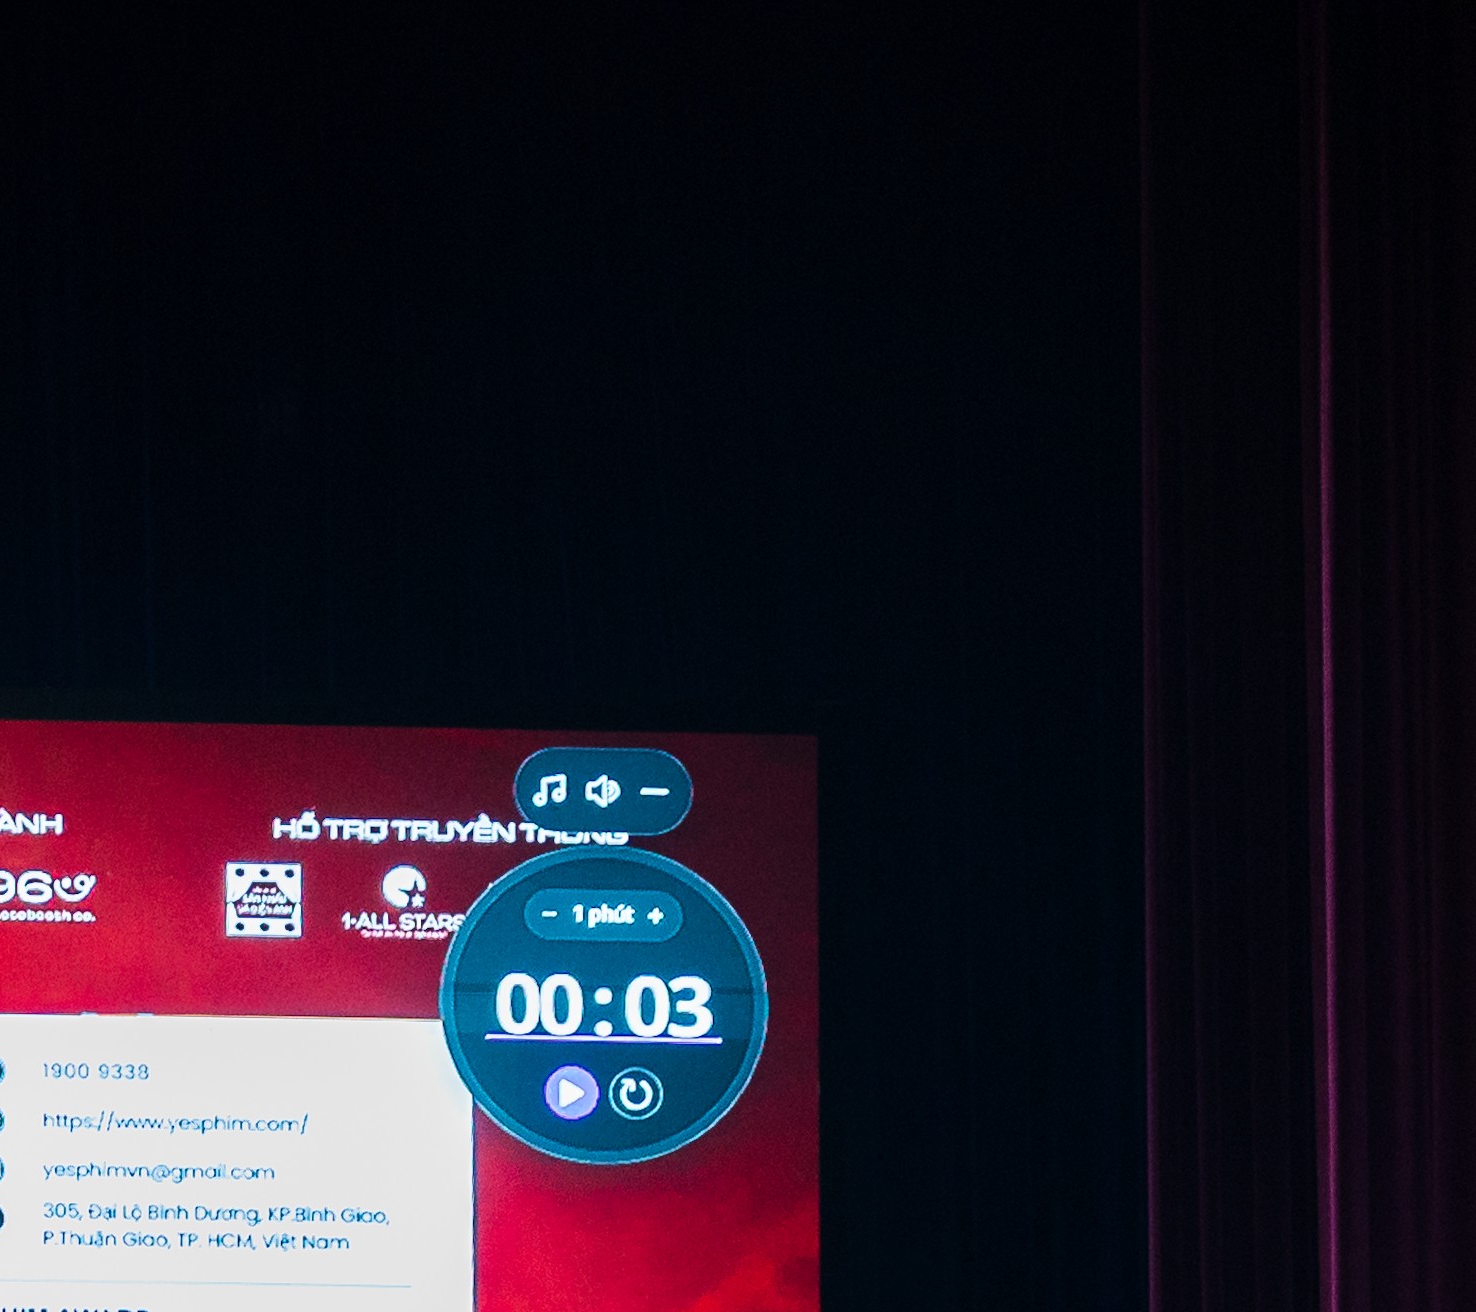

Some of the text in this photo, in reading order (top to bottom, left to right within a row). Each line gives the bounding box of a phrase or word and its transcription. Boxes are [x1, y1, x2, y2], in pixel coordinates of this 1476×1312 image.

[323, 817, 390, 845] TRỢ
[390, 812, 518, 844] TRUYỀN
[72, 911, 97, 923] co.
[398, 912, 467, 933] STARS
[571, 904, 635, 930] 1 phút
[495, 971, 714, 1038] 00:03
[44, 1063, 149, 1080] 1900 9338
[44, 1110, 308, 1135] https://www.yesphim.com/
[43, 1162, 275, 1184] yesphimvn@gmail.com
[44, 1202, 83, 1221] 305,
[123, 1204, 142, 1222] Lộ
[122, 1232, 171, 1249] Giao,
[263, 1233, 296, 1252] Việt
[302, 1235, 349, 1249] Nam
